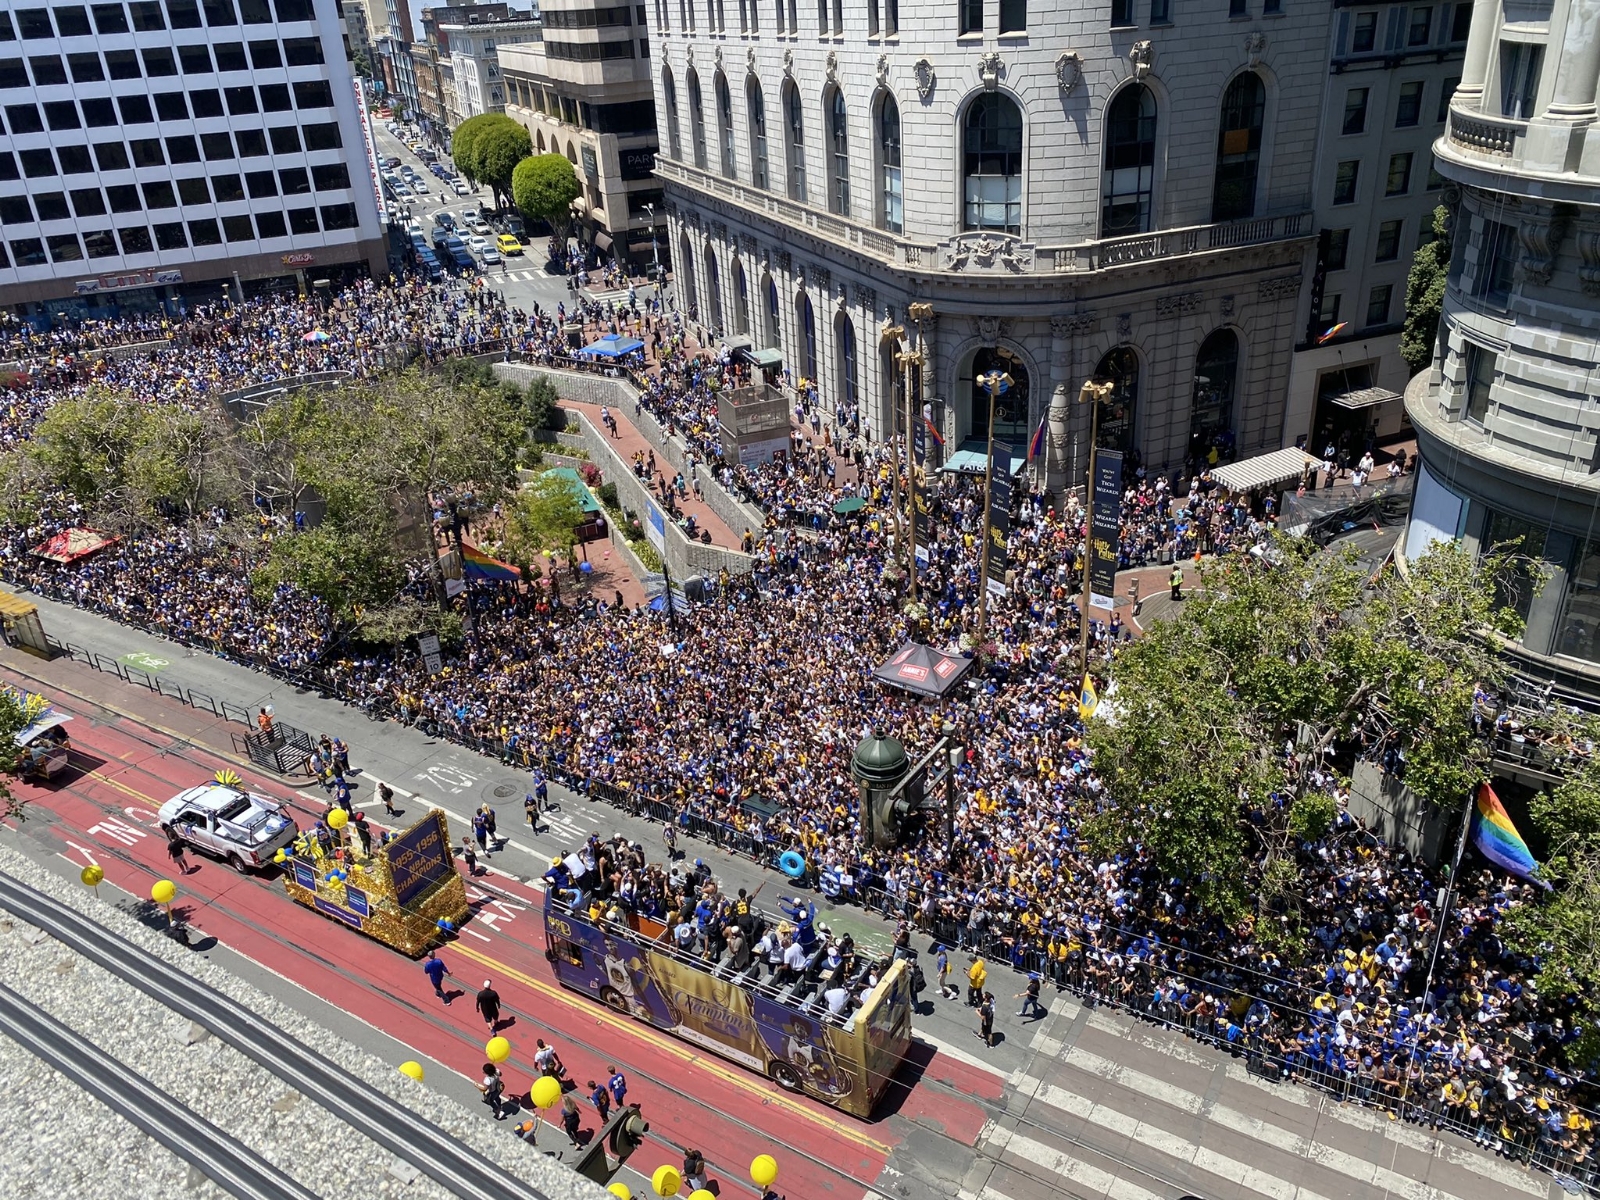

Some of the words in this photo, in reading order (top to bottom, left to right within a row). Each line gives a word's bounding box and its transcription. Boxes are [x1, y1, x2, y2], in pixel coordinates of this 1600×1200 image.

[354, 81, 362, 105] ONE
[359, 109, 375, 170] HALLIDIE
[371, 174, 384, 211] PLAZA
[963, 463, 987, 472] AT&
[1101, 480, 1115, 488] TECH
[1096, 486, 1119, 495] WIZARDS
[1095, 514, 1117, 523] WIZARD
[1094, 520, 1117, 530] WIZARDS
[430, 663, 439, 671] 10
[409, 856, 427, 873] NBA
[396, 853, 442, 894] CHAMPIONS
[737, 901, 747, 915] 33
